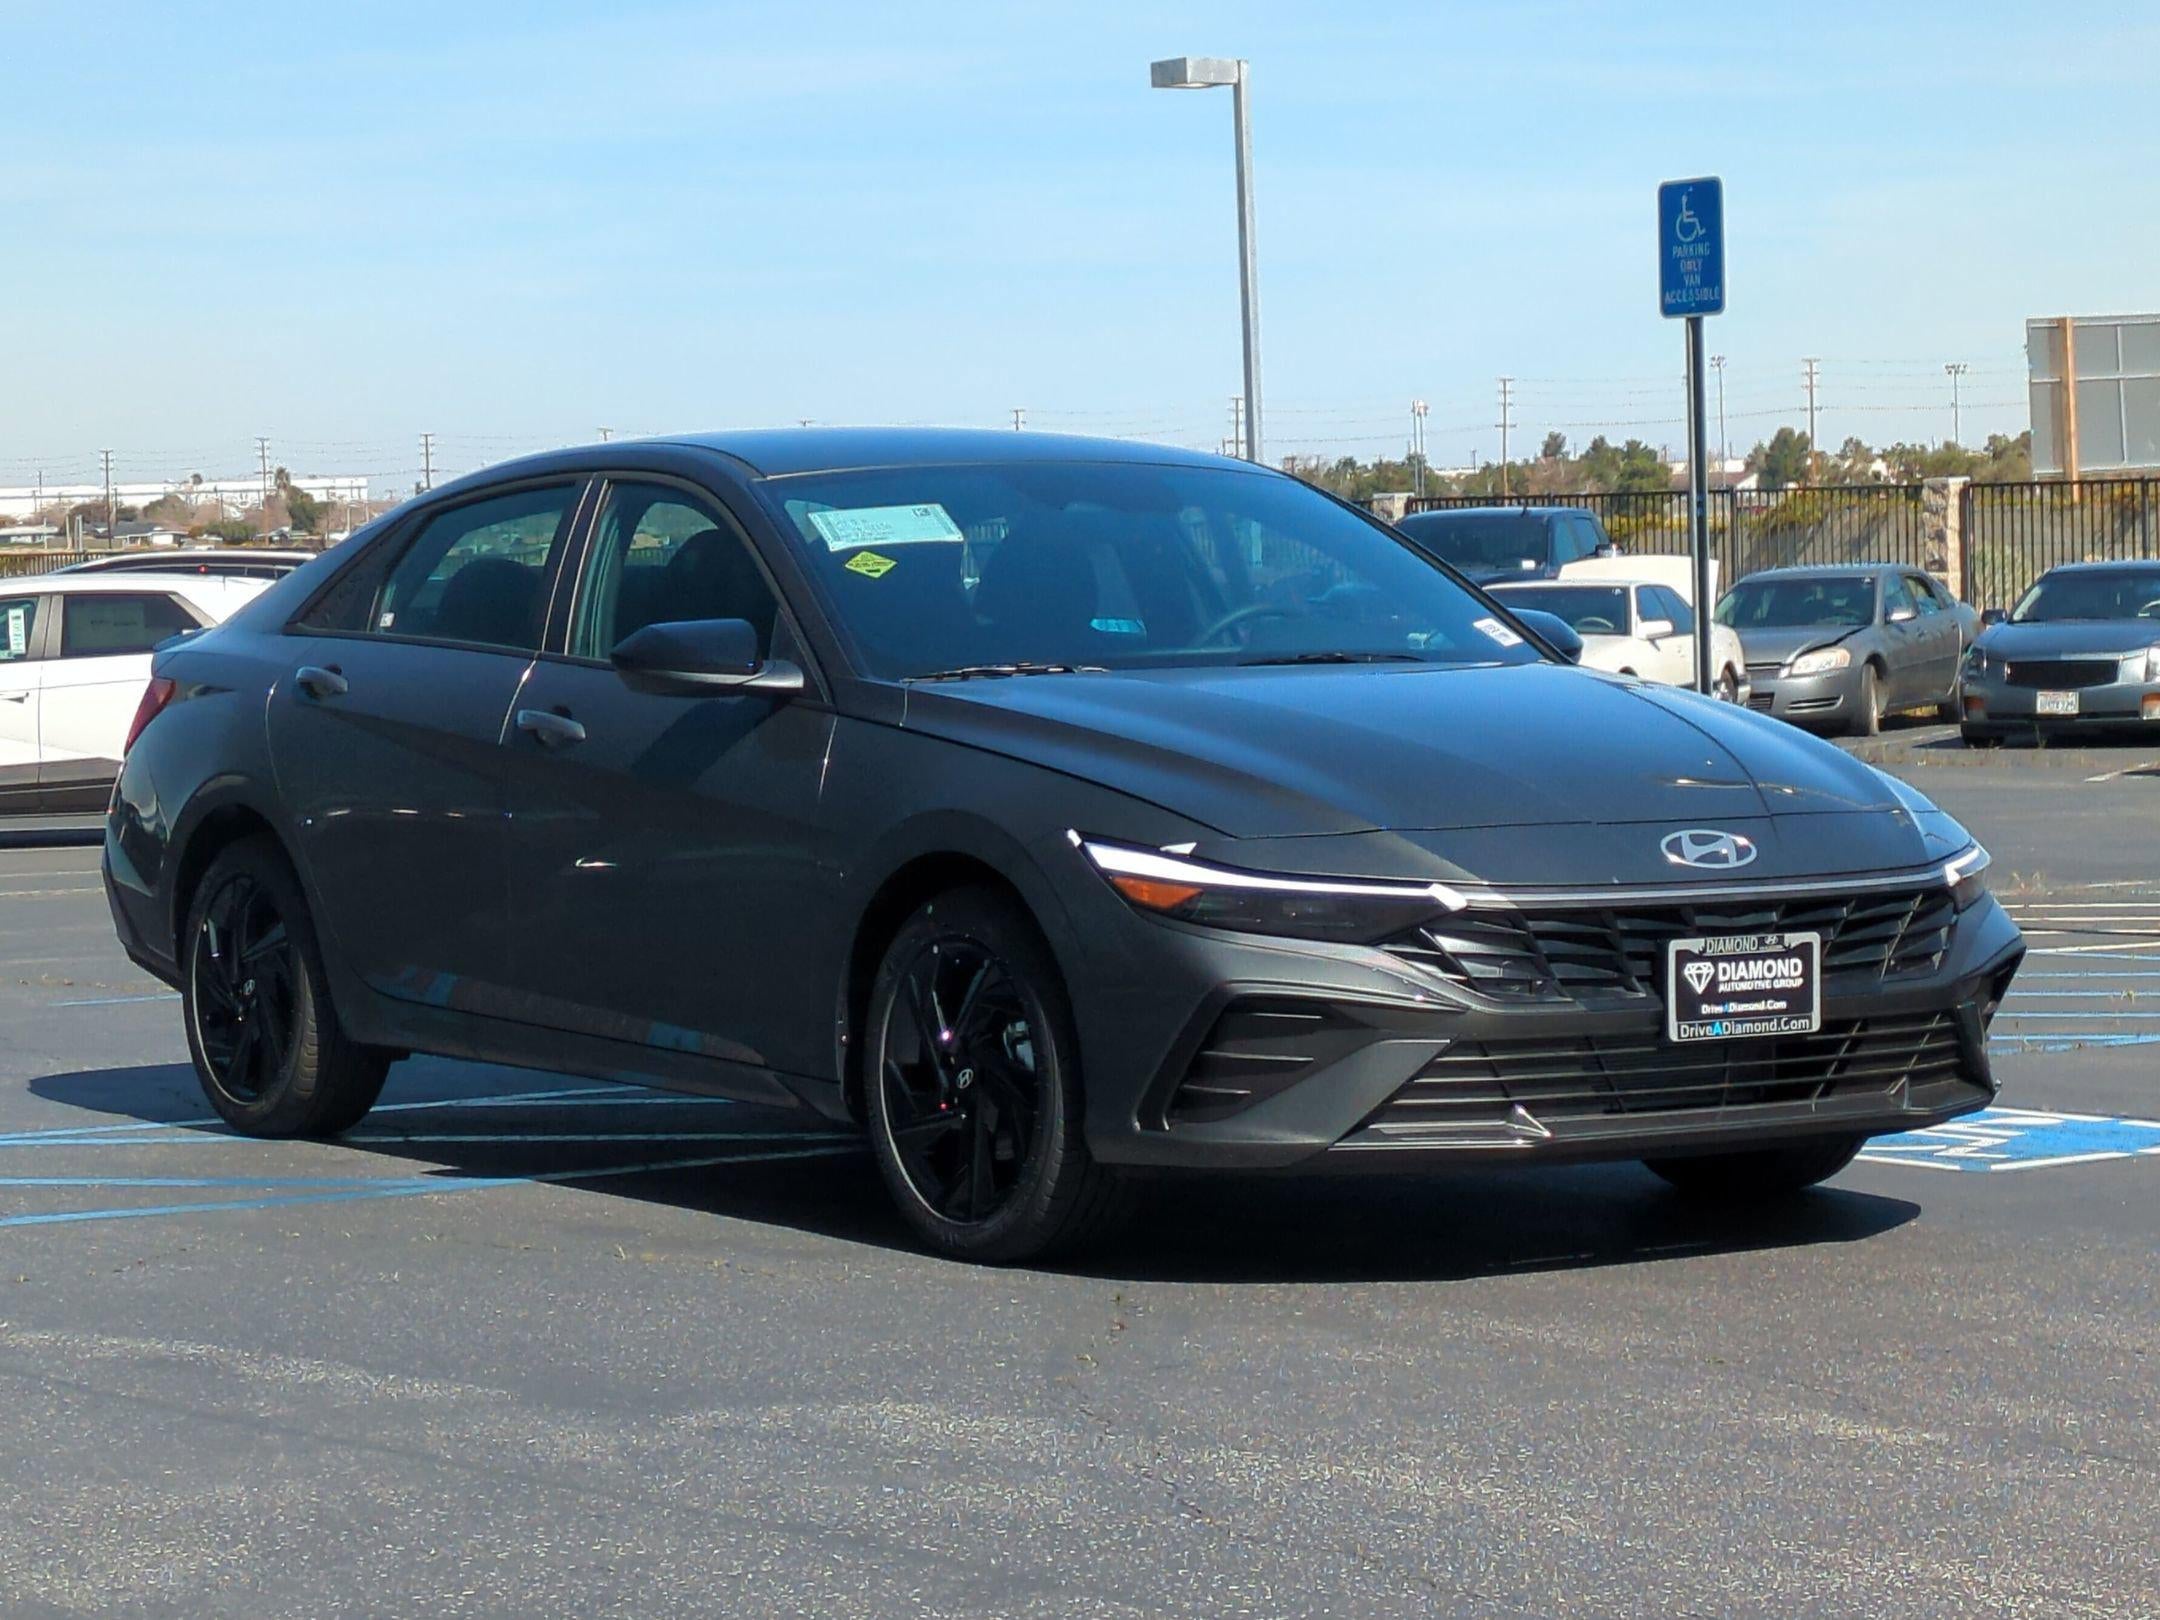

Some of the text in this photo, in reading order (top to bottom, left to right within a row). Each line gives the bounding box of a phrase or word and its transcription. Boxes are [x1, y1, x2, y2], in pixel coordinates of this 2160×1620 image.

[1672, 242, 1710, 258] PARKING
[1680, 259, 1703, 272] ONLY
[1683, 273, 1701, 287] VAN
[1664, 286, 1721, 304] ACCESSIBLE
[1706, 937, 1759, 953] DIAMOND
[1719, 958, 1803, 981] DIAMOND
[1718, 978, 1804, 993] AUTOMOTIVE GROUP
[1680, 1017, 1810, 1038] DriveADiamond.Com
